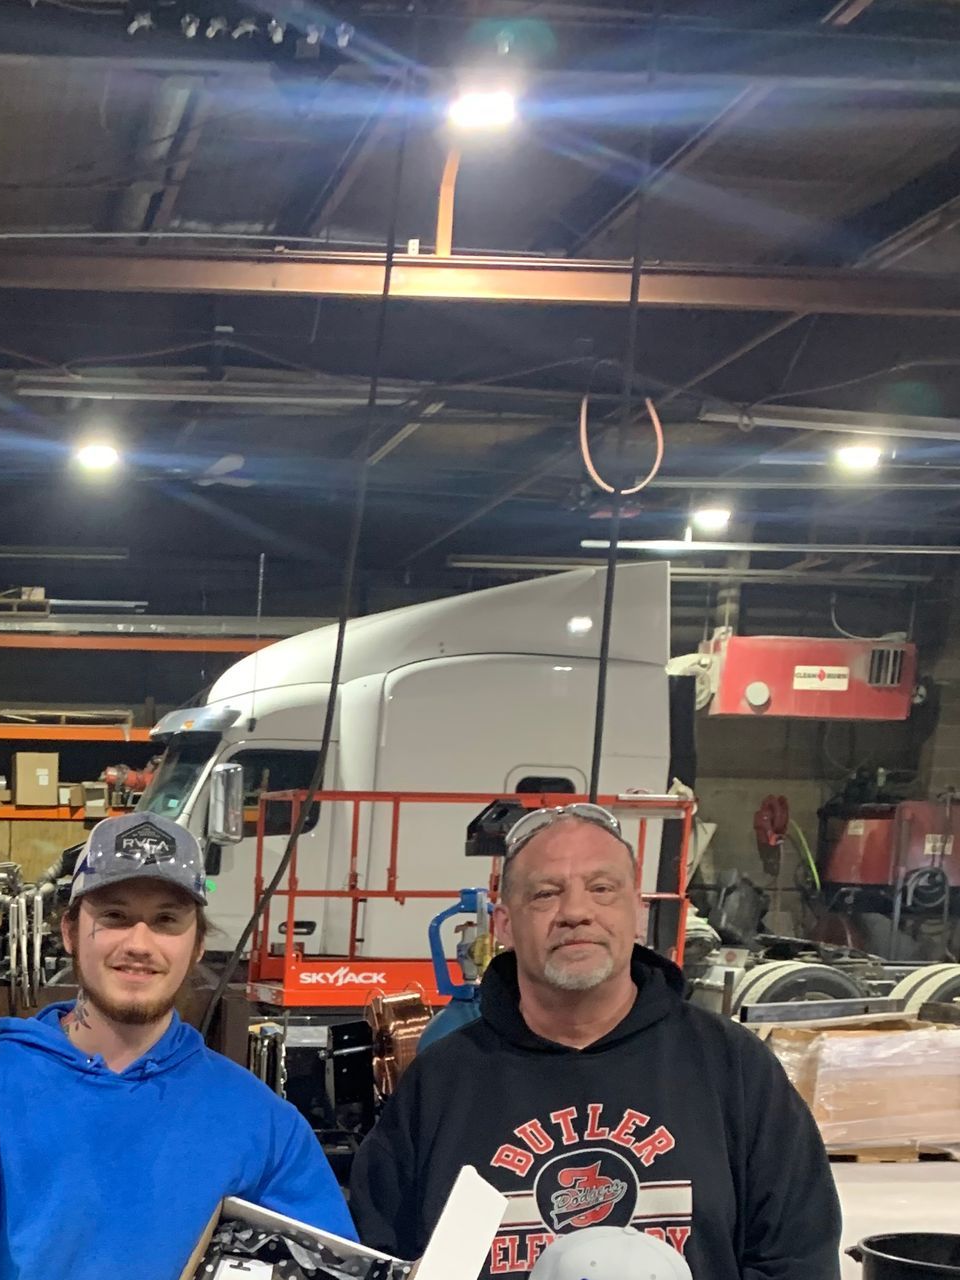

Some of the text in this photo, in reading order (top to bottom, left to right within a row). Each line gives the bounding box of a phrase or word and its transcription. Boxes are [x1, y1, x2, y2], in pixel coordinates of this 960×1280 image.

[299, 966, 387, 987] SKYJACK
[490, 1103, 676, 1178] BUTLER
[551, 1179, 626, 1214] Dodgers
